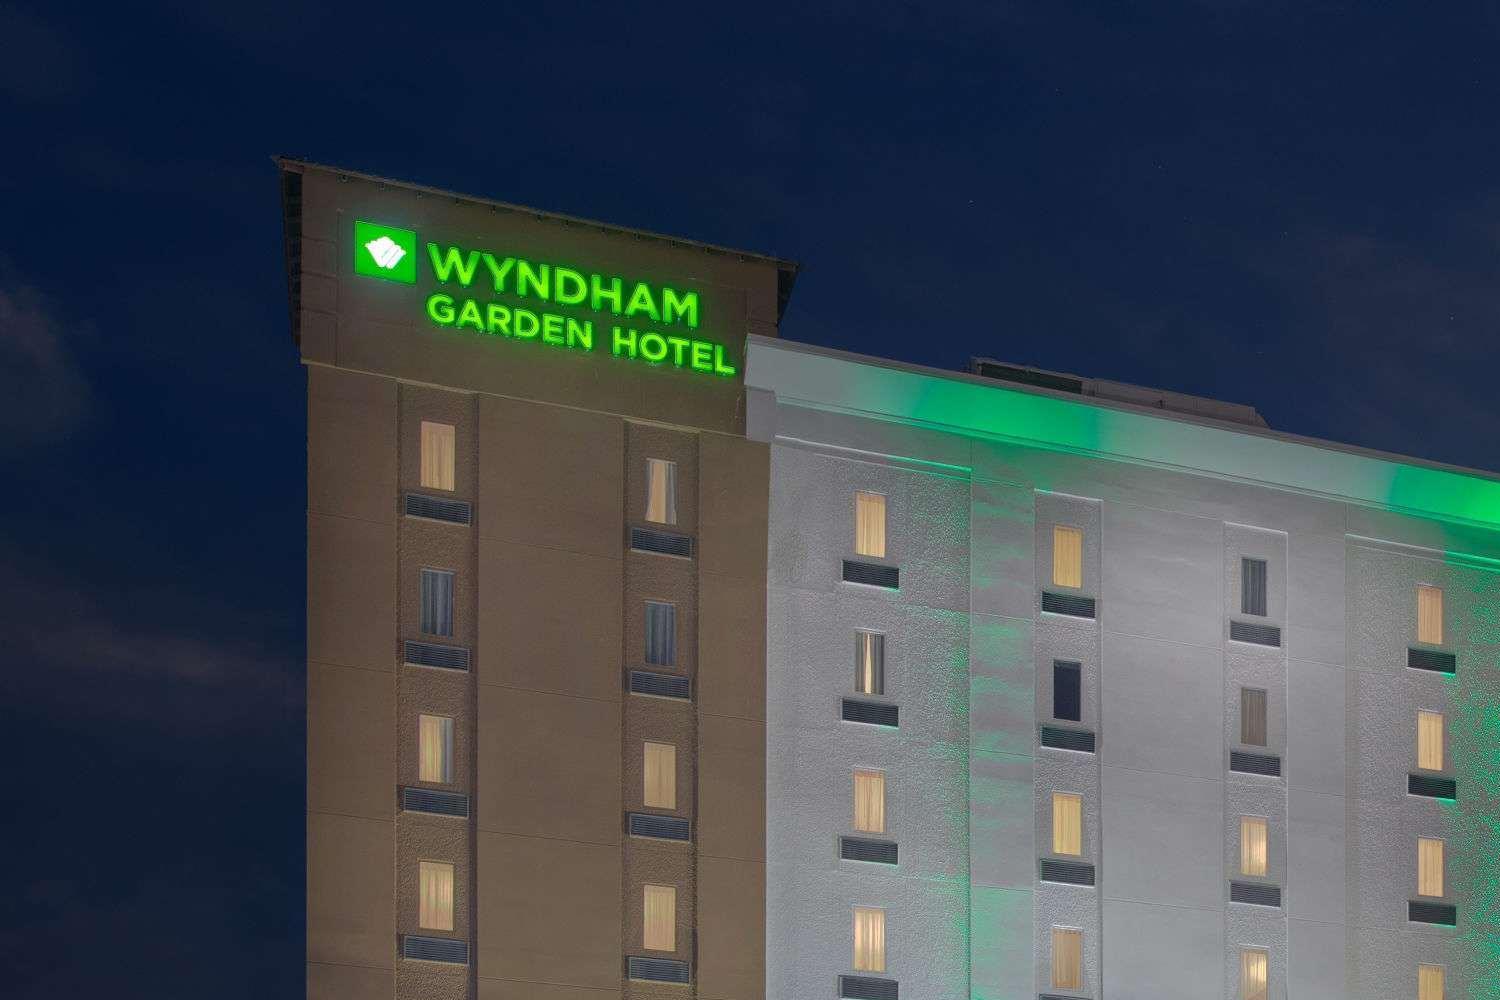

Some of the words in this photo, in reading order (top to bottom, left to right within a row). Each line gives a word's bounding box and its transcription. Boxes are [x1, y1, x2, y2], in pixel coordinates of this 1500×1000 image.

[427, 243, 699, 329] WYNDHAM
[426, 294, 593, 350] GARDEN
[612, 326, 736, 376] HOTEL
